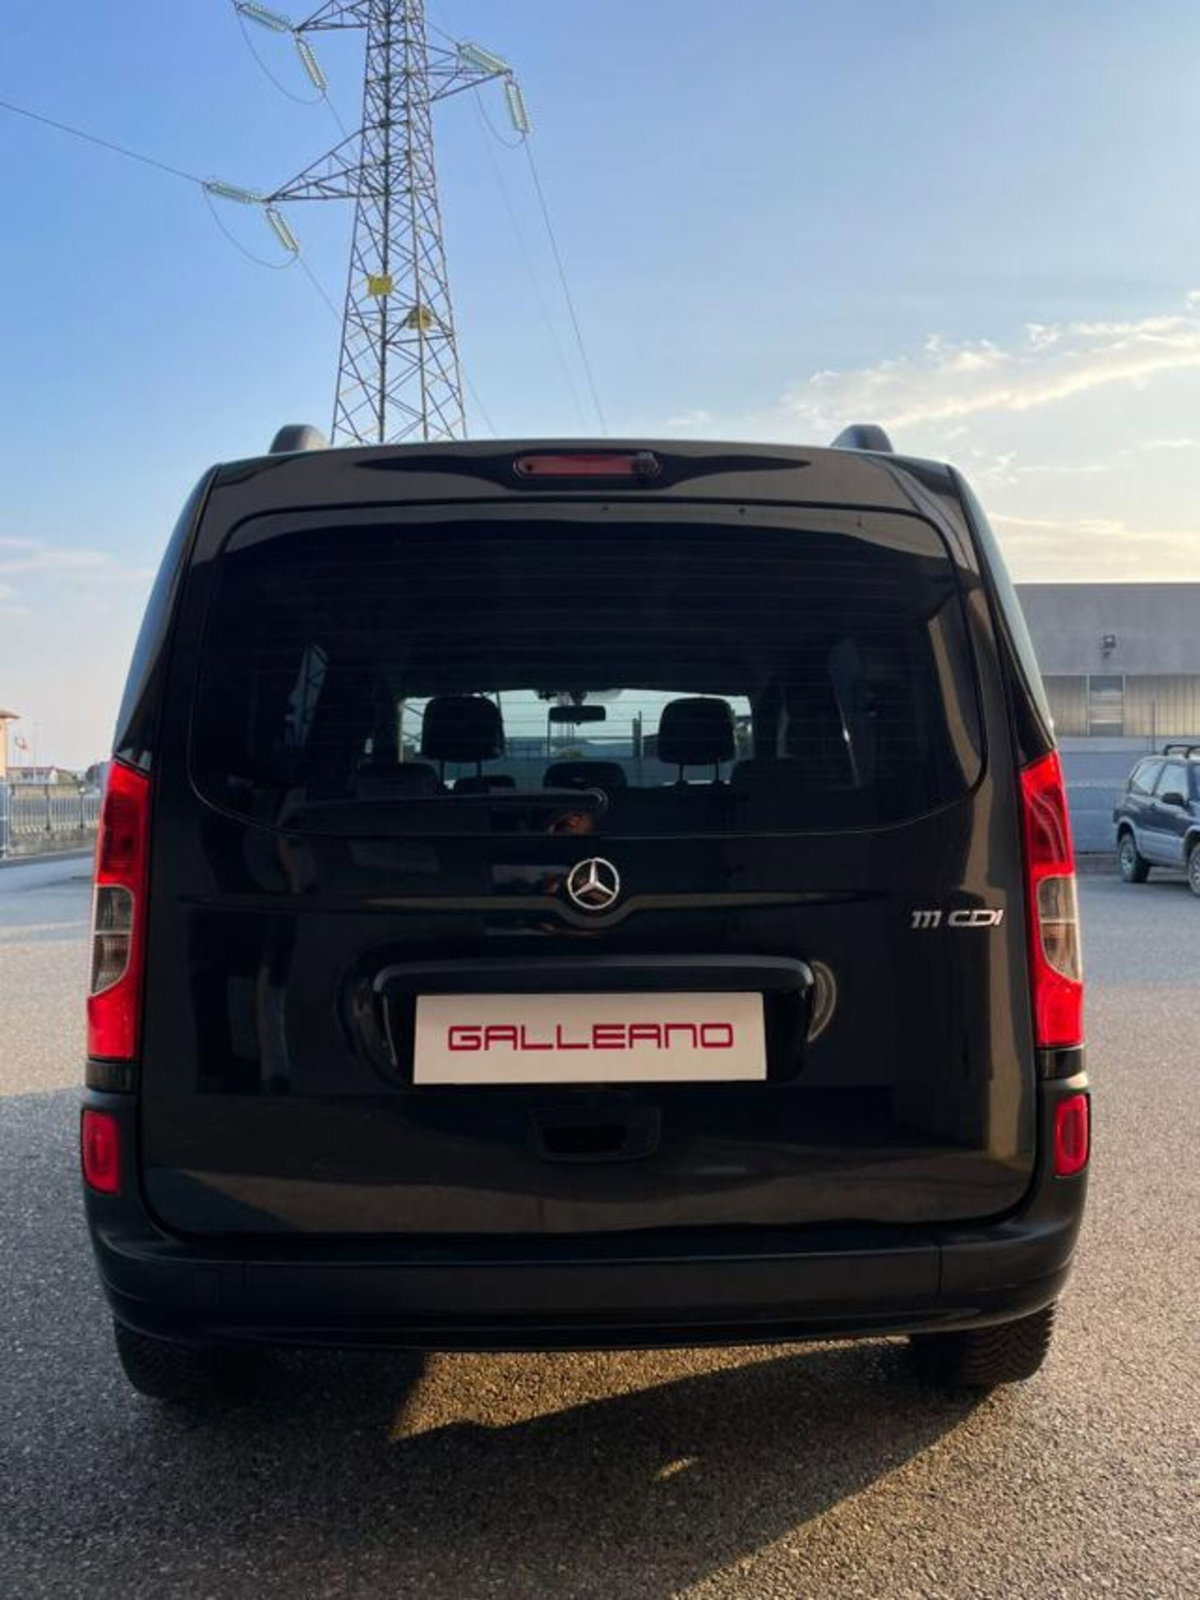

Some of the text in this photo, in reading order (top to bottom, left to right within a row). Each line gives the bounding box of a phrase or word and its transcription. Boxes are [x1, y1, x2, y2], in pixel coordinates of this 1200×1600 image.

[911, 909, 1004, 929] 111 CDI
[448, 1023, 734, 1051] GALLEANO
